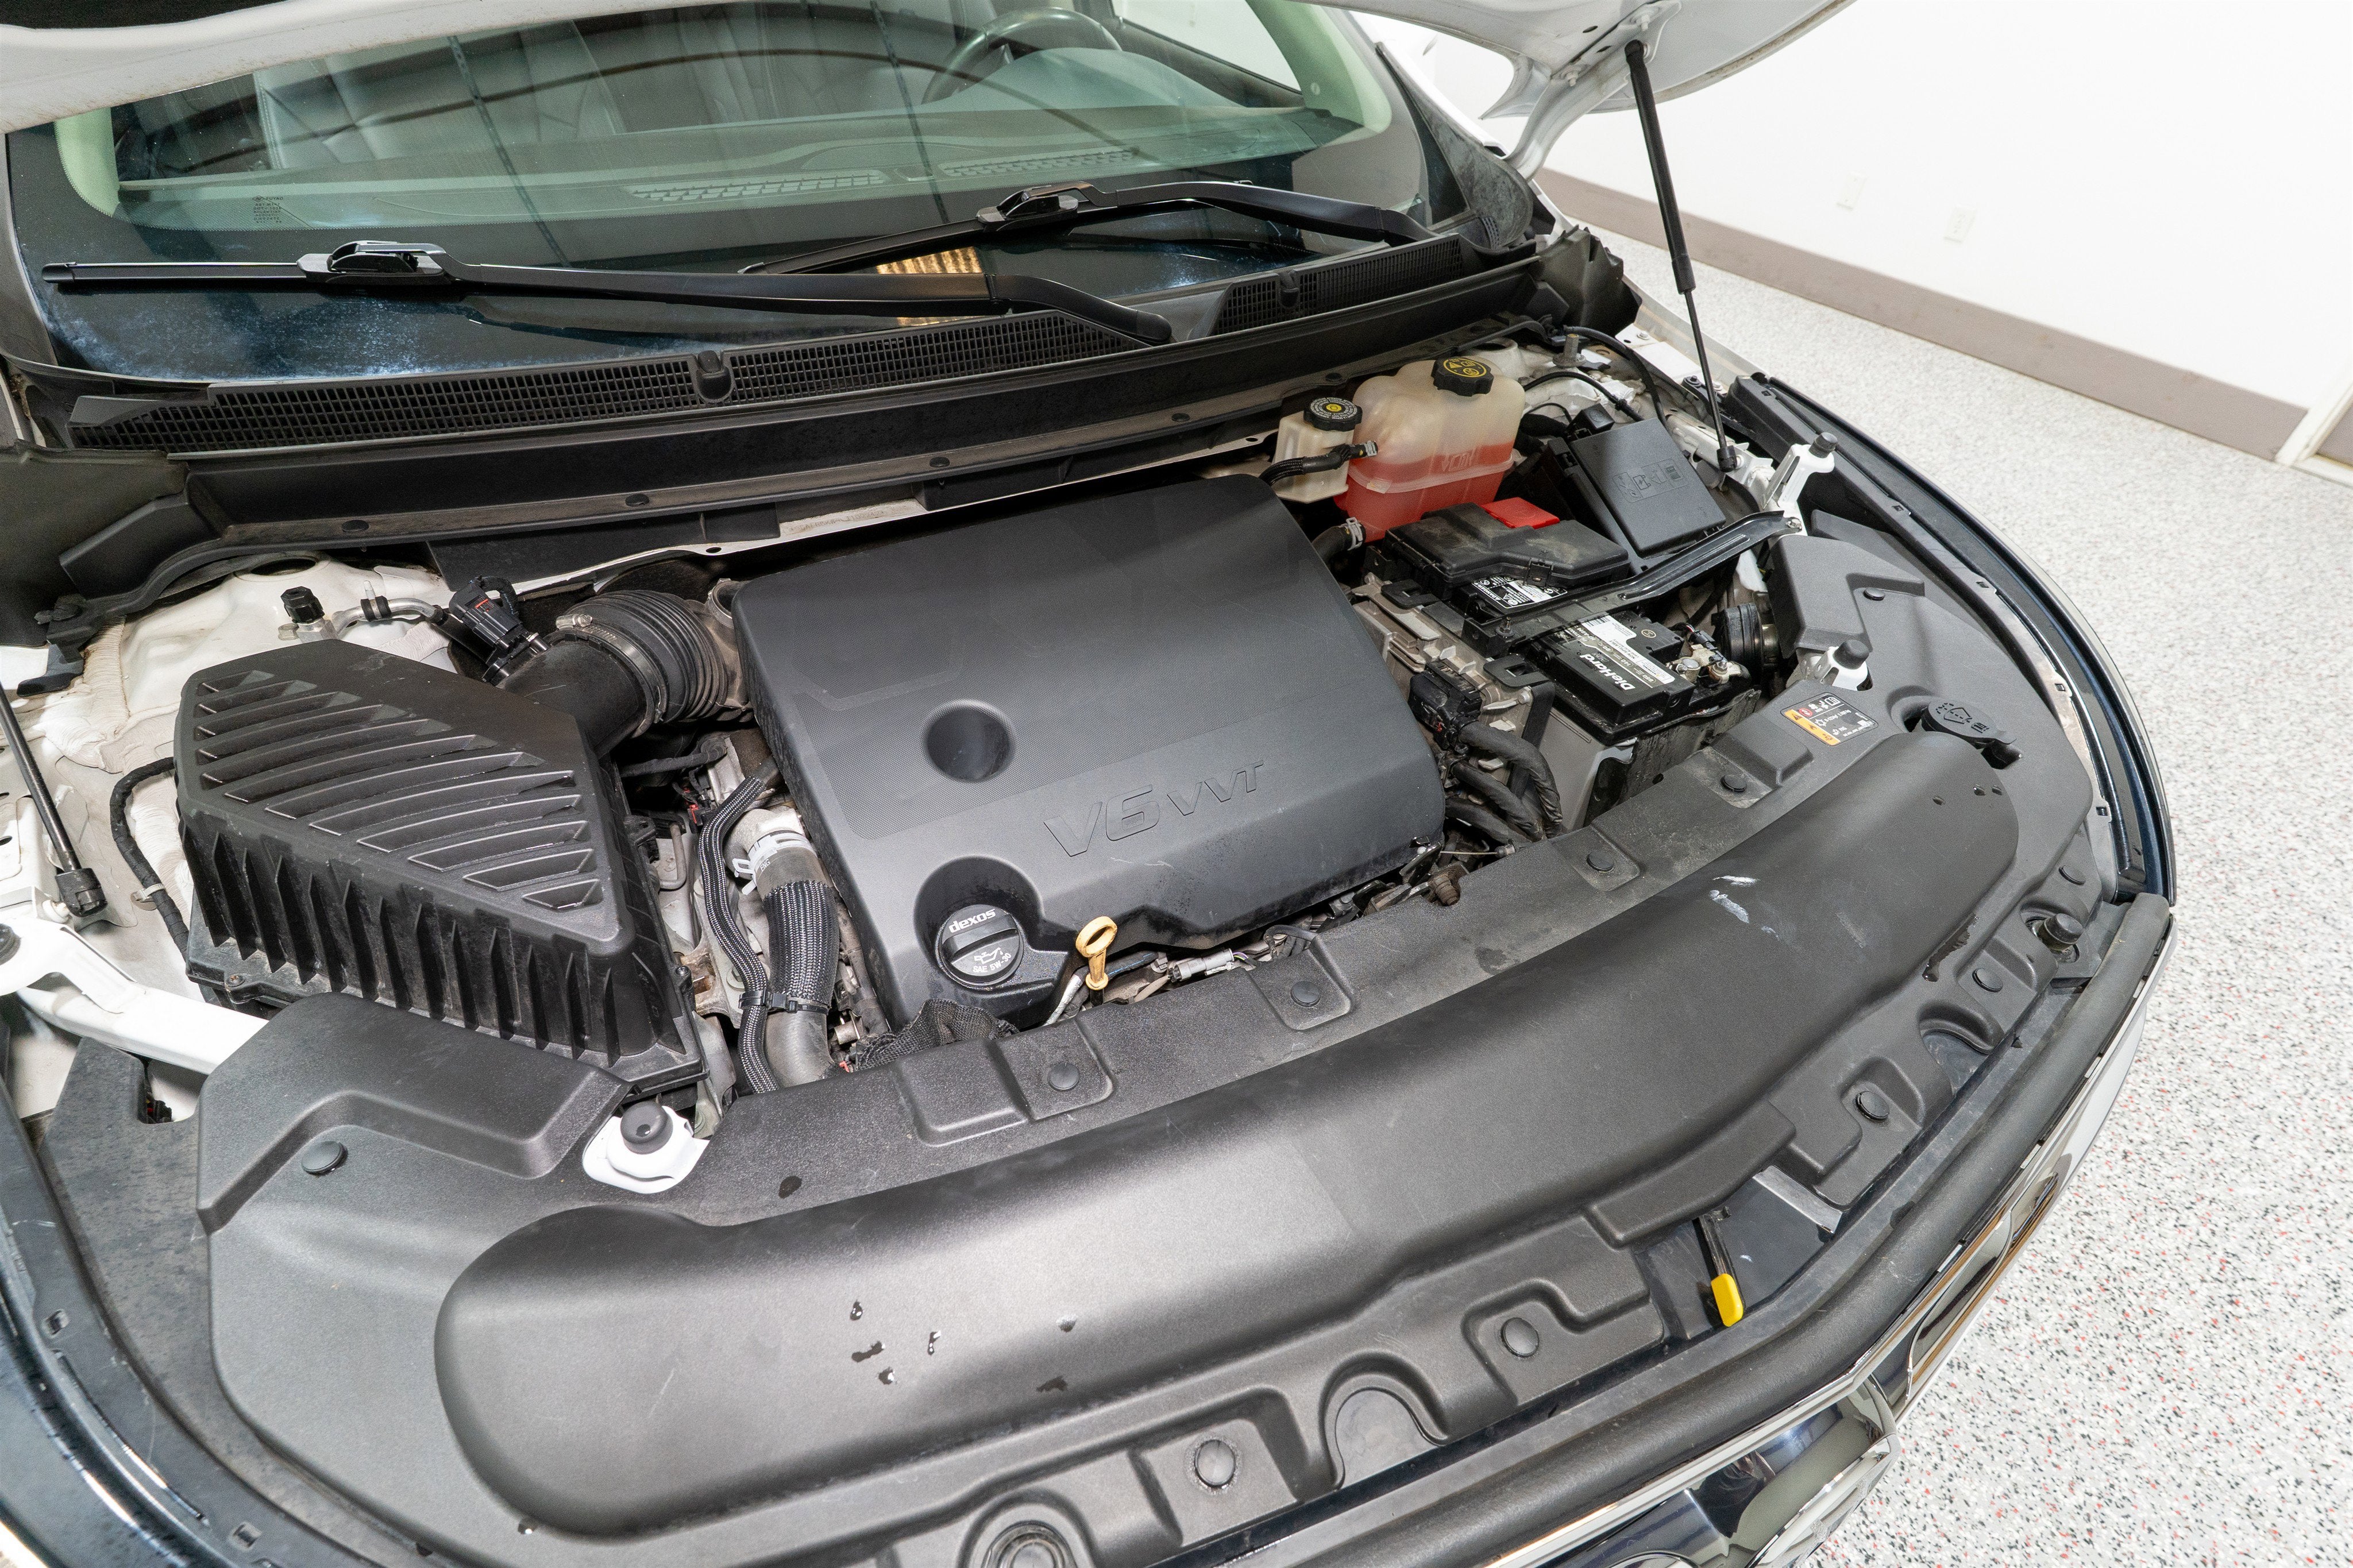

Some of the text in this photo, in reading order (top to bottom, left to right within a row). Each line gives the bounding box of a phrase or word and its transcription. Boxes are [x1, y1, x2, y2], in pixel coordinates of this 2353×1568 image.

[1579, 654, 1636, 690] DieHard
[1043, 760, 1264, 857] V6 VVT
[759, 858, 771, 872] ENG
[948, 908, 996, 933] dexos
[972, 952, 1012, 973] SAE 5W-30
